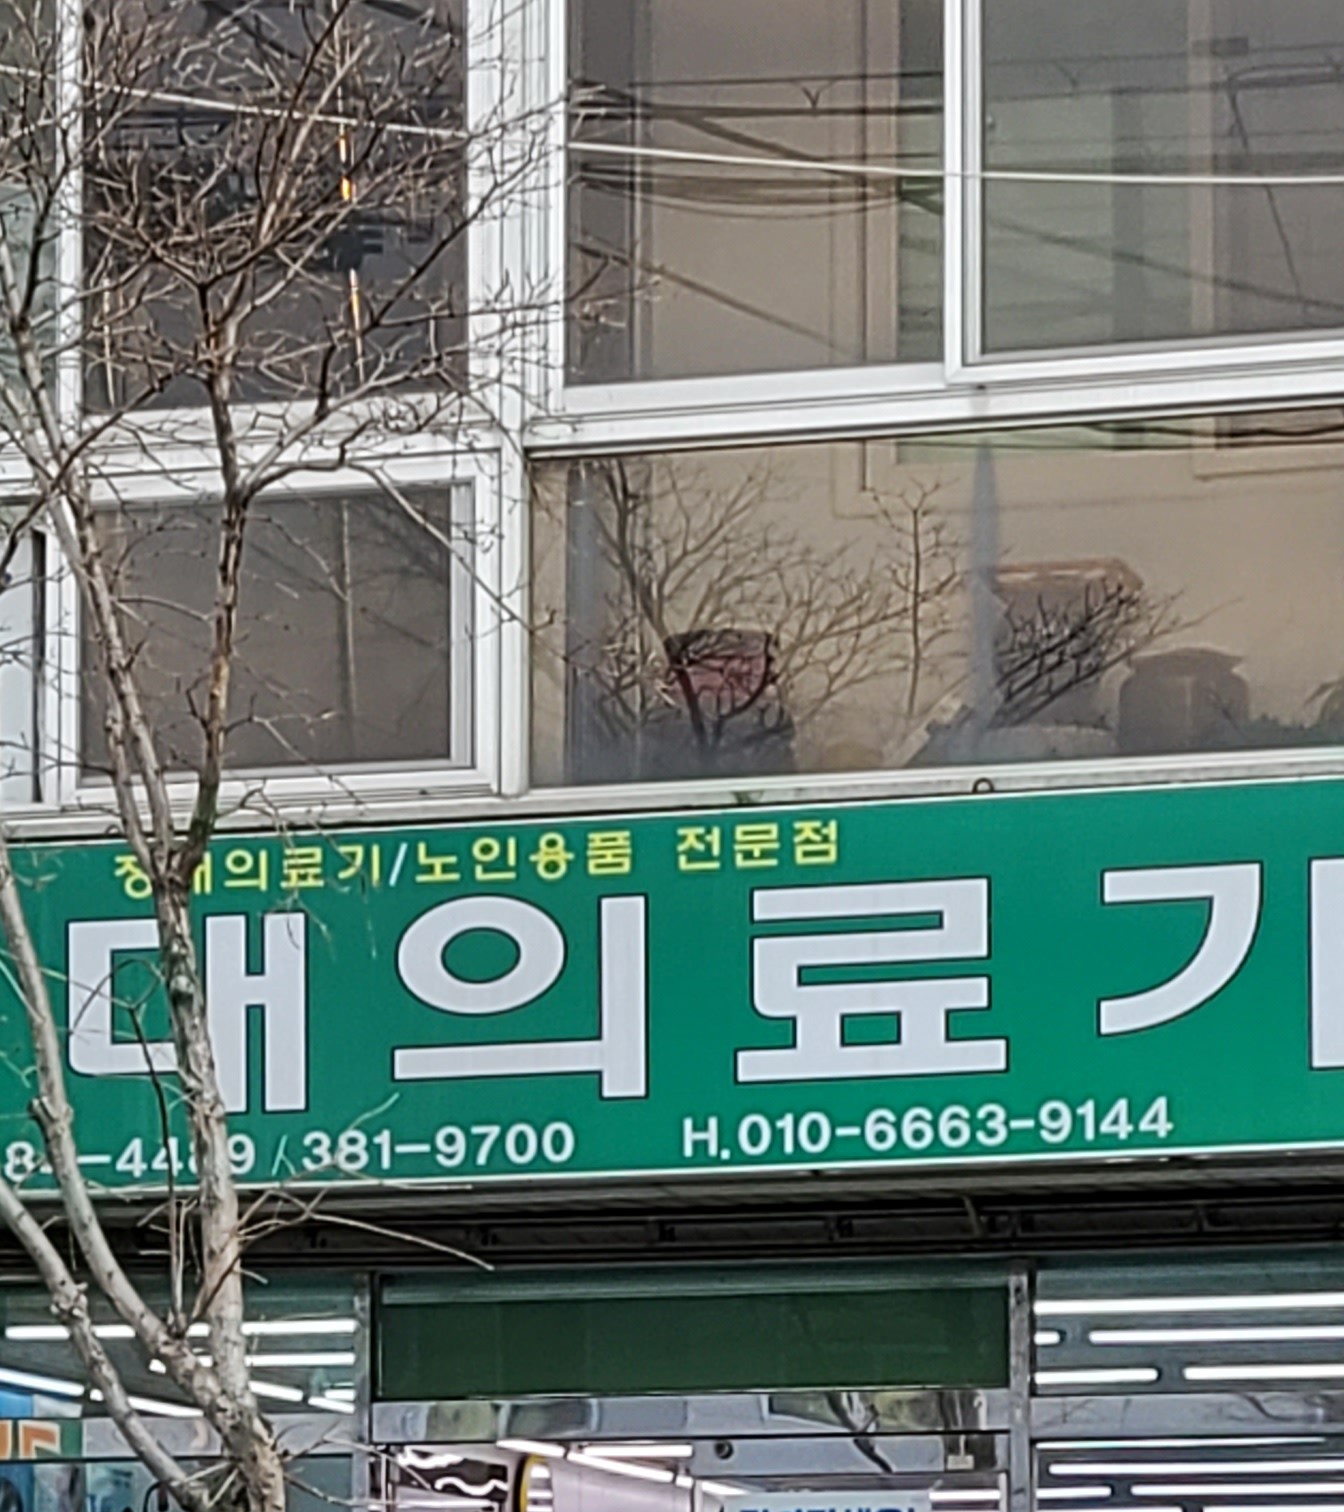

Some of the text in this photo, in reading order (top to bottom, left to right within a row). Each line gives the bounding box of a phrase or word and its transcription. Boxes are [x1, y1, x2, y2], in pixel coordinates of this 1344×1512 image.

[675, 820, 840, 874] 전문점
[302, 1121, 575, 1172] 381-9700
[682, 1097, 1174, 1161] H.010-6663-9144
